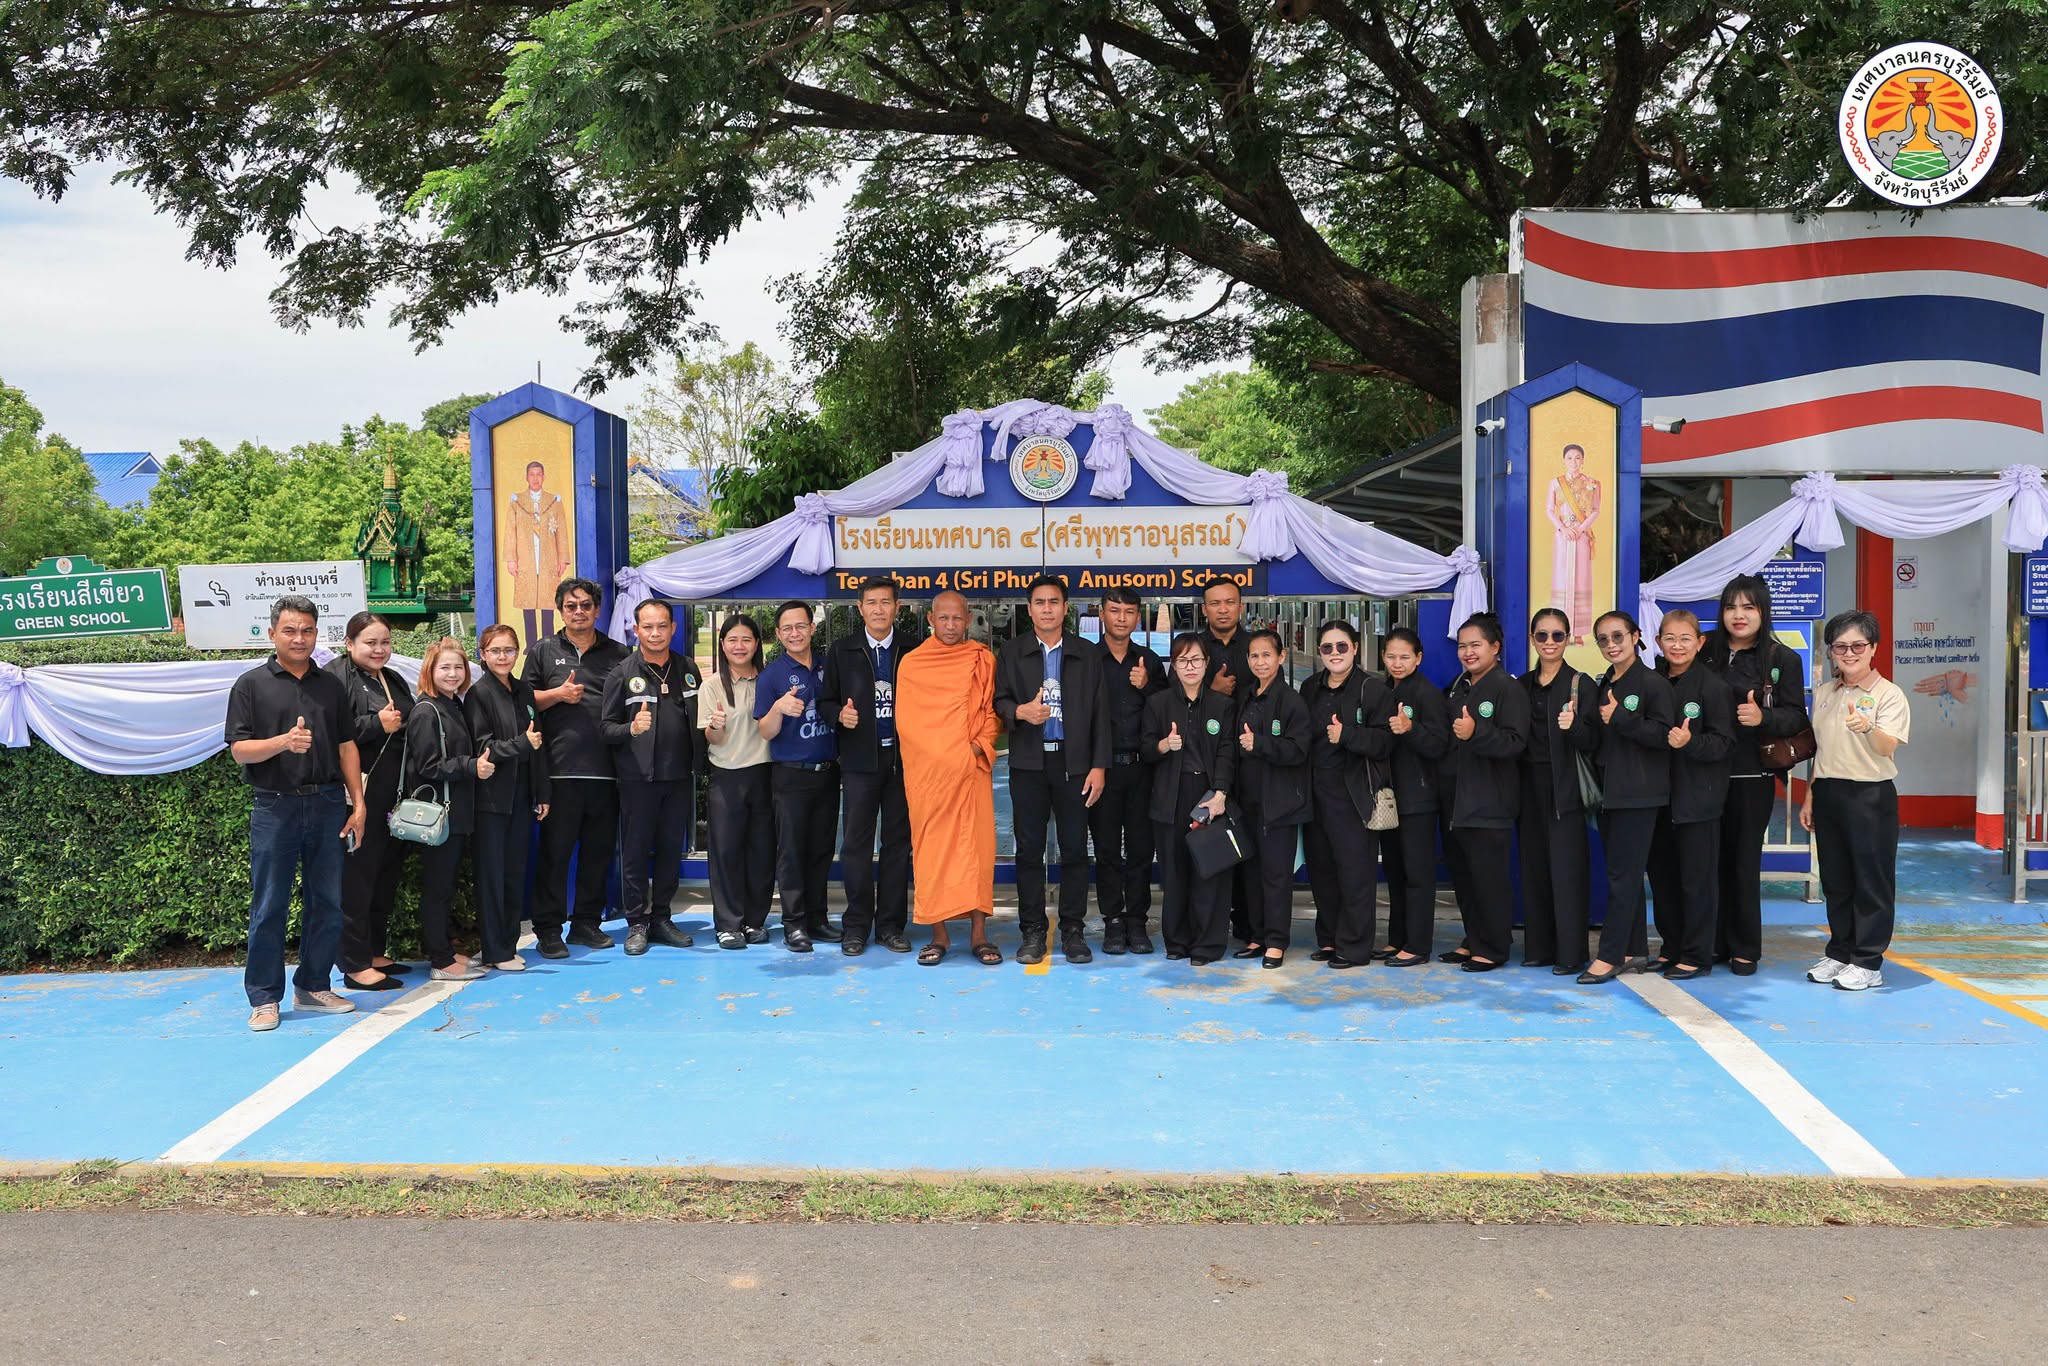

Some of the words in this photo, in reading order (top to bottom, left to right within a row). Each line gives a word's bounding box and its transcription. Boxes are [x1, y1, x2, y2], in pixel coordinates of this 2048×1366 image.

[836, 516, 1011, 550] โรงเรียนเทศบาล
[1020, 526, 1041, 548] ๔
[255, 565, 338, 592] ห้ามสูบบุหรี่
[935, 571, 948, 590] 4
[953, 570, 988, 591] (Sri
[1079, 569, 1176, 590] Anusorn)
[14, 616, 65, 630] GREEN
[69, 611, 131, 627] SCHOOL
